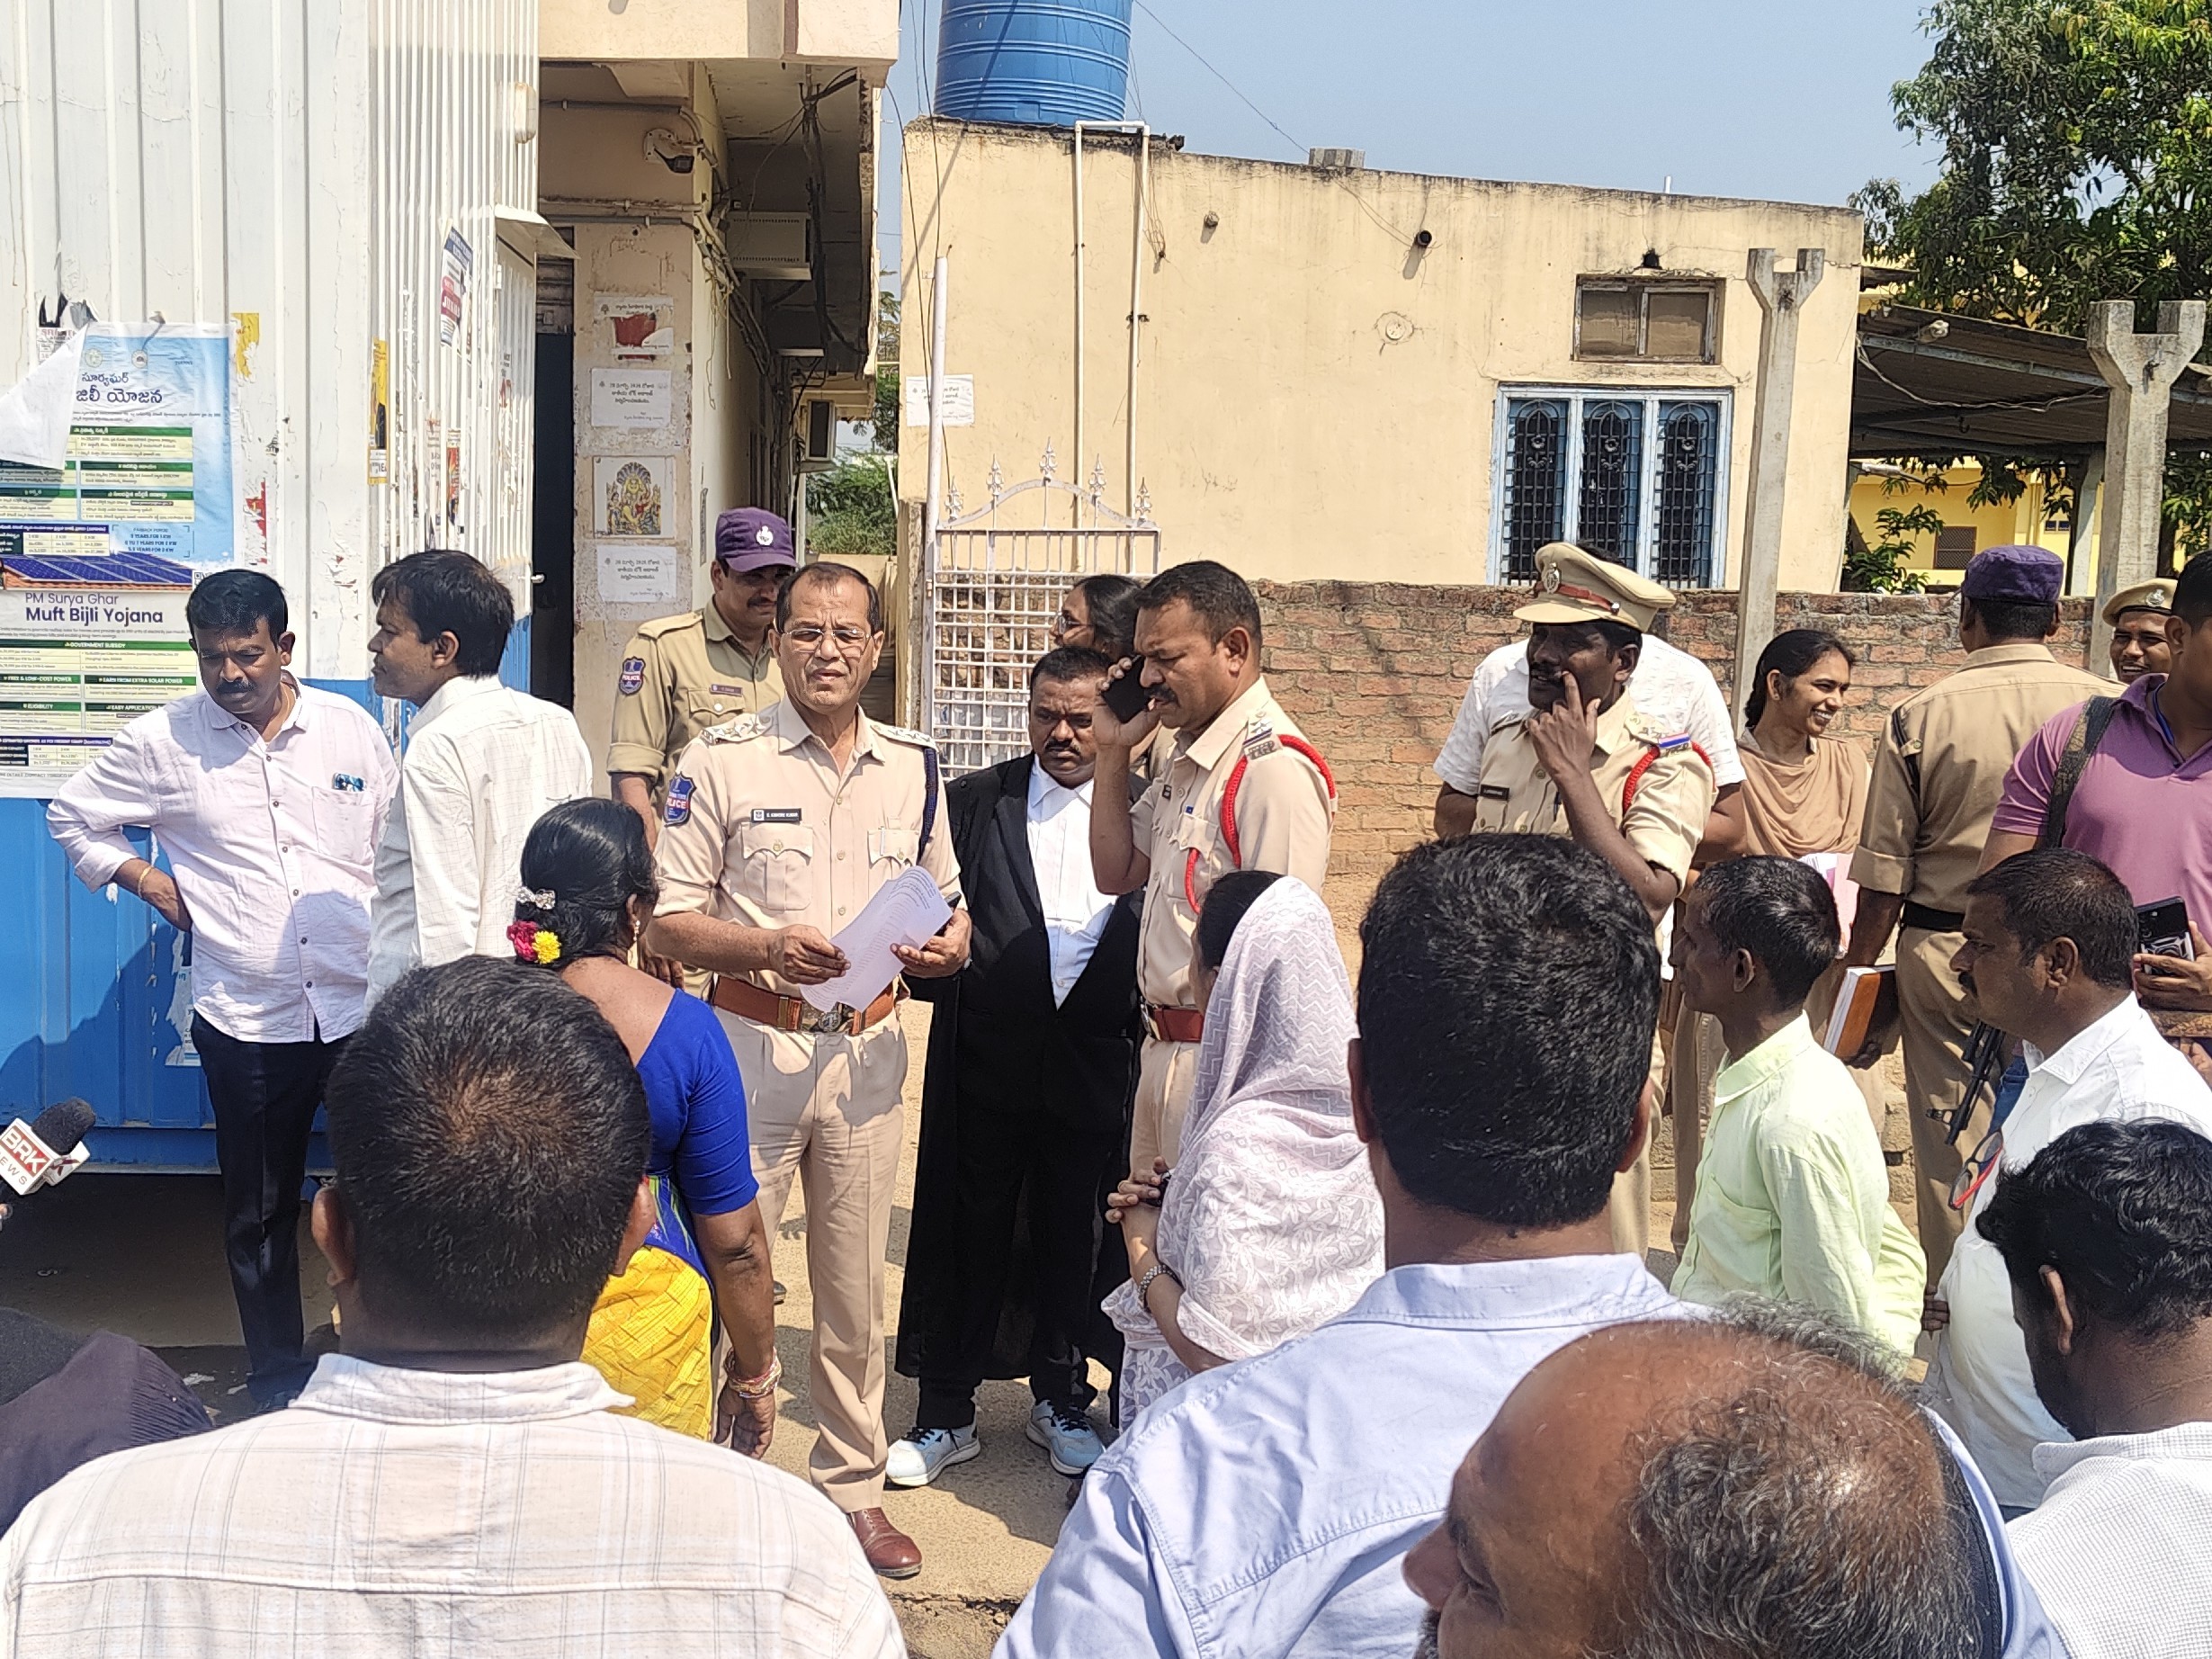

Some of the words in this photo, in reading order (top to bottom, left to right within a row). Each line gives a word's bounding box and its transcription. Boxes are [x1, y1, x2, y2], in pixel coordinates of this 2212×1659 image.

[82, 372, 130, 387] సూర్యఘర్
[106, 388, 163, 404] యోజన
[25, 592, 44, 604] PM
[48, 592, 84, 607] Surya
[87, 592, 119, 605] Ghar
[26, 606, 65, 622] Muft
[69, 606, 99, 627] Bijli
[103, 607, 164, 628] Yojana
[1, 1128, 48, 1174] BRK
[0, 1156, 28, 1186] EWS
